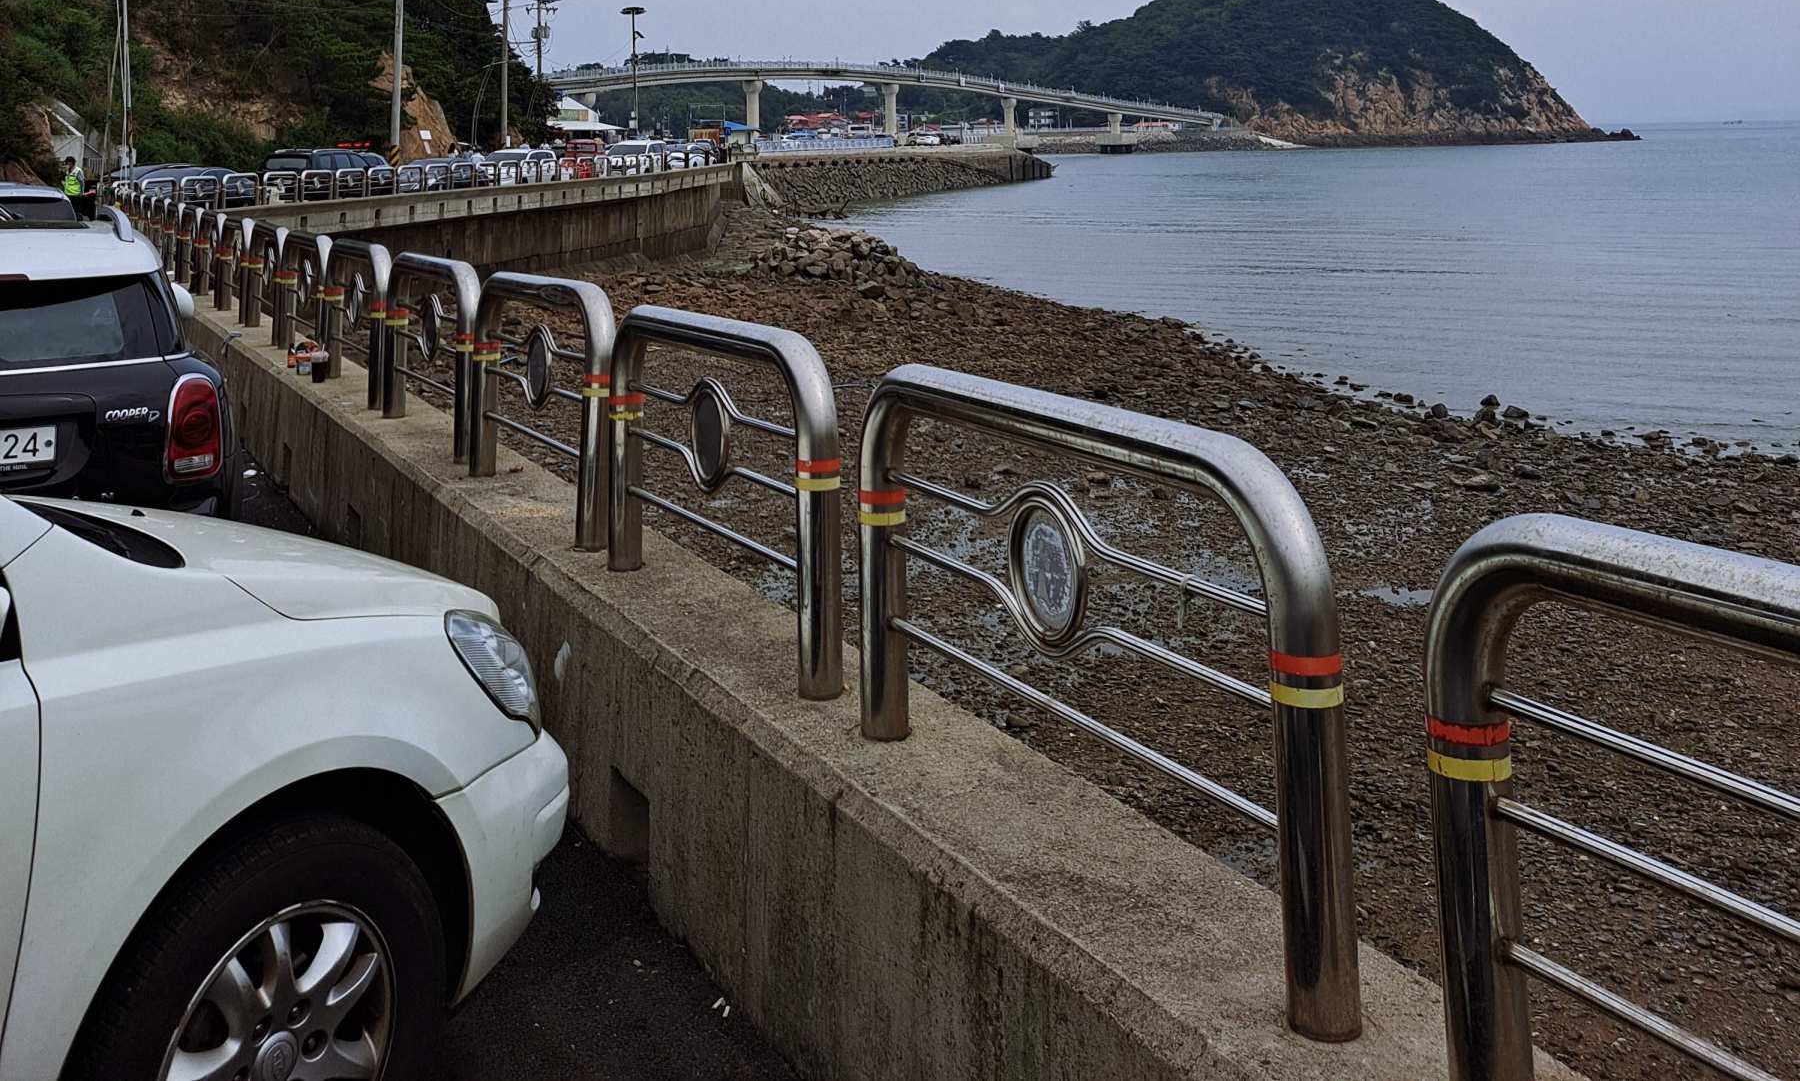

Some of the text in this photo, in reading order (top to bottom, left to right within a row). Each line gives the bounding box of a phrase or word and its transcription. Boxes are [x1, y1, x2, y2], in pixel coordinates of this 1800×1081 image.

[105, 406, 160, 422] COOPER D
[3, 431, 39, 460] 24
